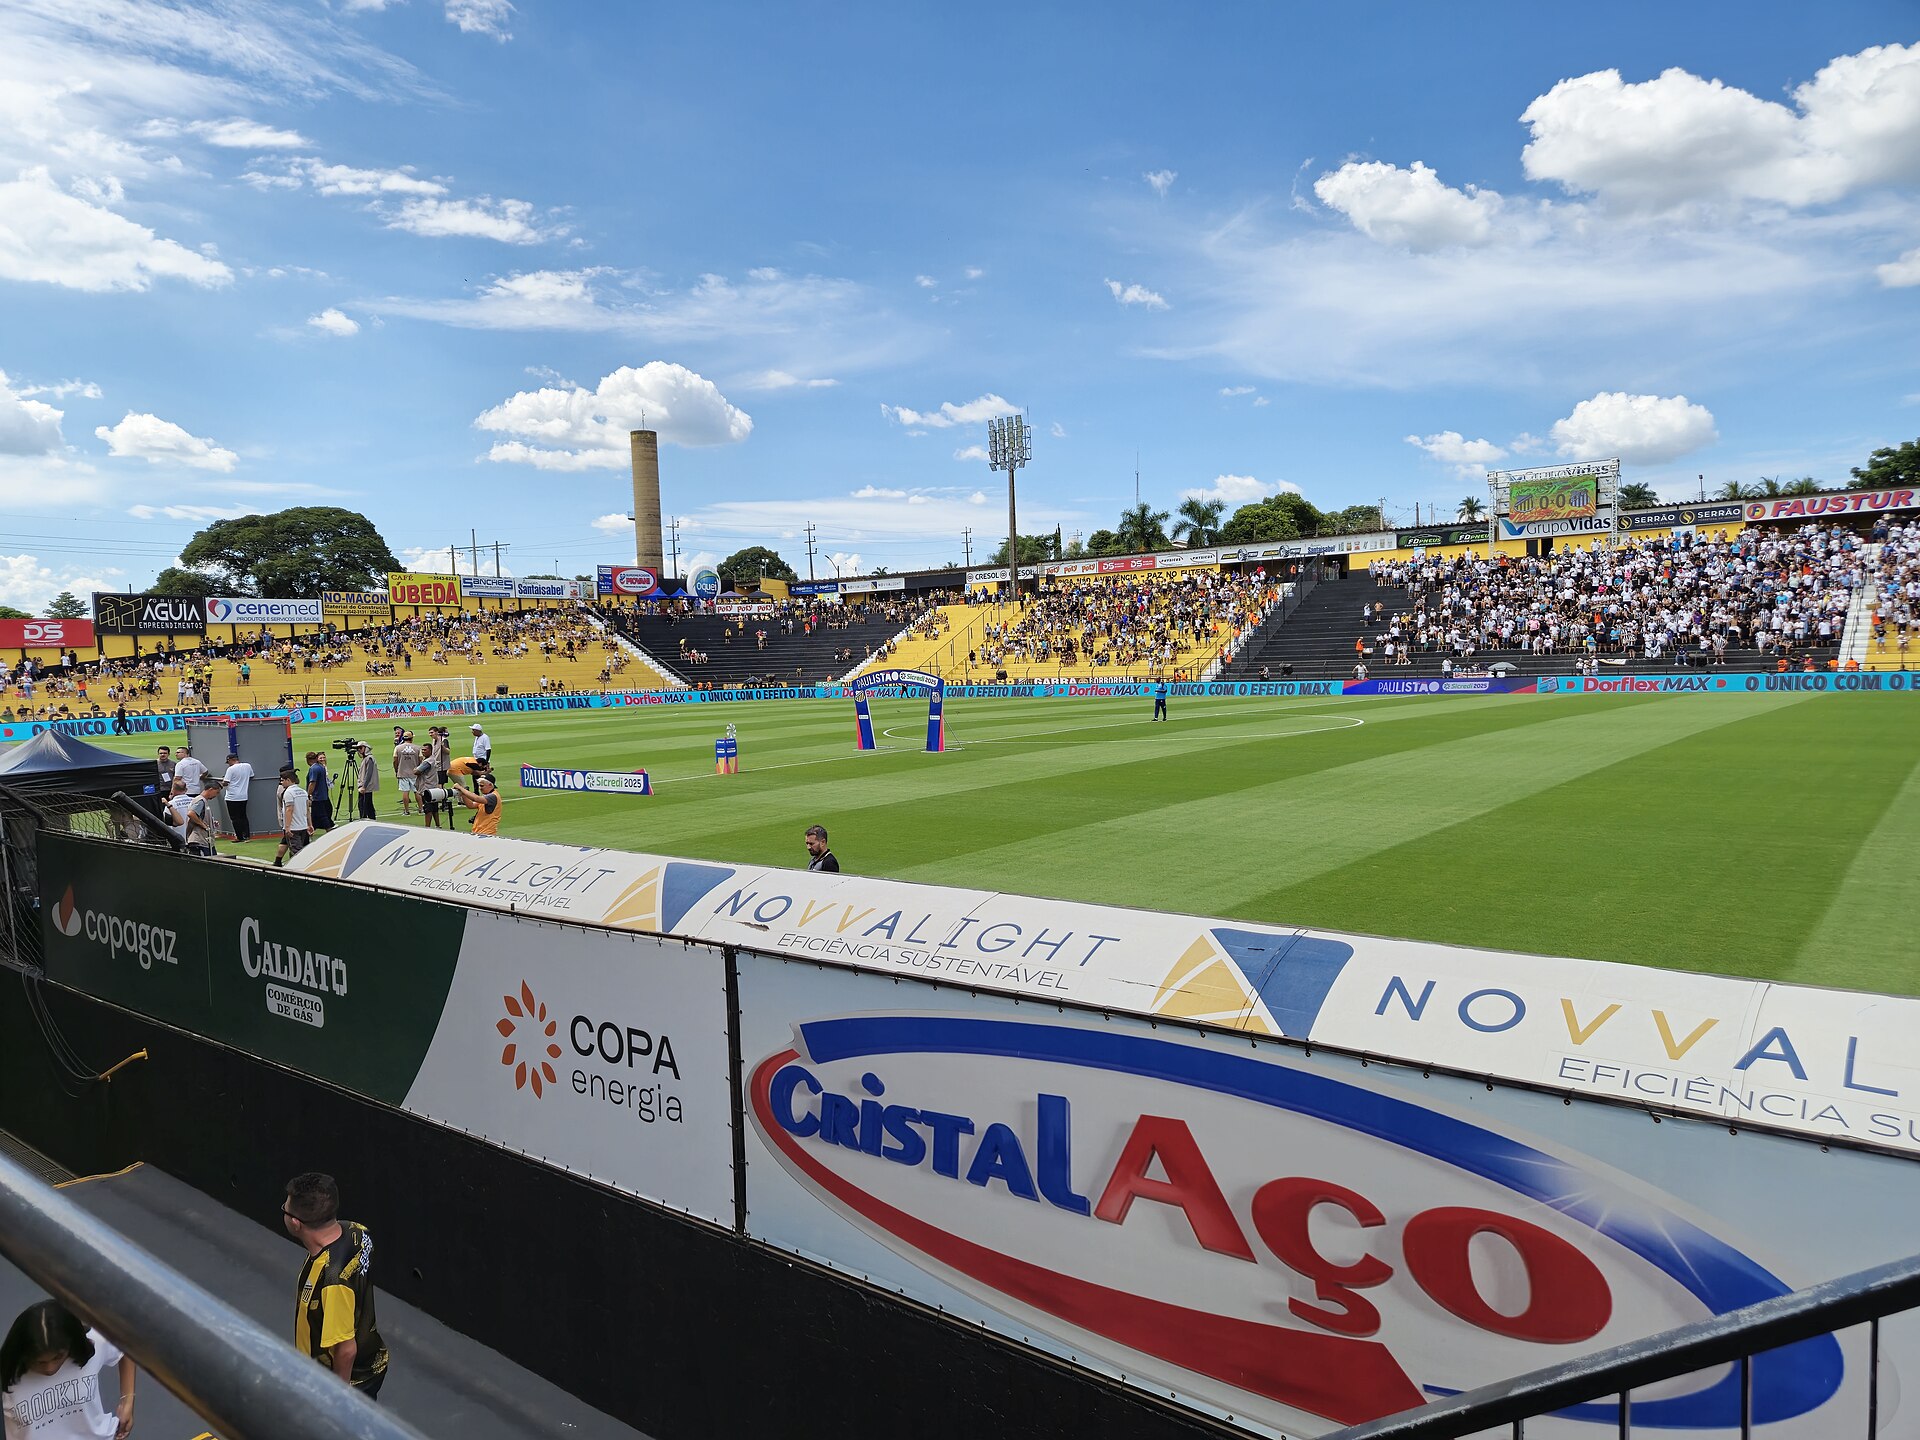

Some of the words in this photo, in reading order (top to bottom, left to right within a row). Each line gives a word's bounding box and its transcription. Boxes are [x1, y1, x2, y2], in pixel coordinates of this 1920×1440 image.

[1539, 495, 1549, 509] 0
[1556, 493, 1566, 508] 0
[1771, 490, 1914, 518] FAUSTUR
[1634, 514, 1675, 524] SERRÃO
[1697, 508, 1741, 519] SERRÃO
[1526, 517, 1611, 536] GrupoVidas
[975, 572, 999, 580] CRESOL
[391, 581, 459, 605] ÚBEDA
[517, 583, 564, 596] Santaisabel
[696, 581, 717, 593] oquei
[323, 592, 389, 604] NO-MACON
[142, 598, 201, 621] ÁGUIA
[235, 600, 319, 615] cenemed
[23, 624, 64, 640] DS
[138, 621, 204, 630] EMPREENDIMENTOS
[876, 687, 898, 697] MAX
[946, 687, 965, 697] COM
[968, 687, 975, 697] O
[976, 687, 1008, 697] EFEITO
[1011, 686, 1035, 697] MAX
[1067, 686, 1113, 697] Dorflex
[1113, 684, 1141, 696] MAX
[1208, 683, 1235, 696] COM
[1239, 683, 1249, 696] O
[1251, 683, 1295, 696] EFEITO
[1298, 682, 1332, 695] MAX
[1583, 677, 1661, 692] Dorflex
[1662, 676, 1711, 691] MAX
[1745, 676, 1759, 691] O
[1834, 674, 1882, 691] COM
[1888, 674, 1904, 690] O
[489, 699, 514, 711] COM
[517, 699, 525, 711] O
[528, 698, 564, 710] EFEITO
[567, 697, 592, 709] MAX
[624, 694, 665, 705] Dorflex
[664, 693, 685, 704] MAX
[700, 692, 707, 702] O
[736, 690, 753, 701] COM
[763, 688, 795, 700] EFEITO
[798, 688, 816, 699] MAX
[596, 776, 623, 788] Sicredi
[624, 778, 642, 789] 2025
[380, 844, 616, 894] NOVVALIGHT
[410, 875, 478, 898] EFICIÊNCIA
[477, 886, 572, 910] SUSTENTÁVEL
[713, 889, 1121, 968] NOVVALIGHT
[85, 909, 179, 970] copagaz
[239, 916, 348, 997] CALDATO
[776, 933, 891, 963] EFICIÊNCIA
[896, 950, 1070, 991] SUSTENTÁVEL
[267, 987, 322, 1013] COMÉRCIO
[276, 1001, 292, 1017] DE
[293, 1004, 314, 1023] GÁS
[570, 1015, 681, 1081] COPA
[572, 1068, 683, 1124] energia
[1558, 1057, 1850, 1129] EFICIÊNCIA
[10, 1374, 97, 1429] ROOKLY
